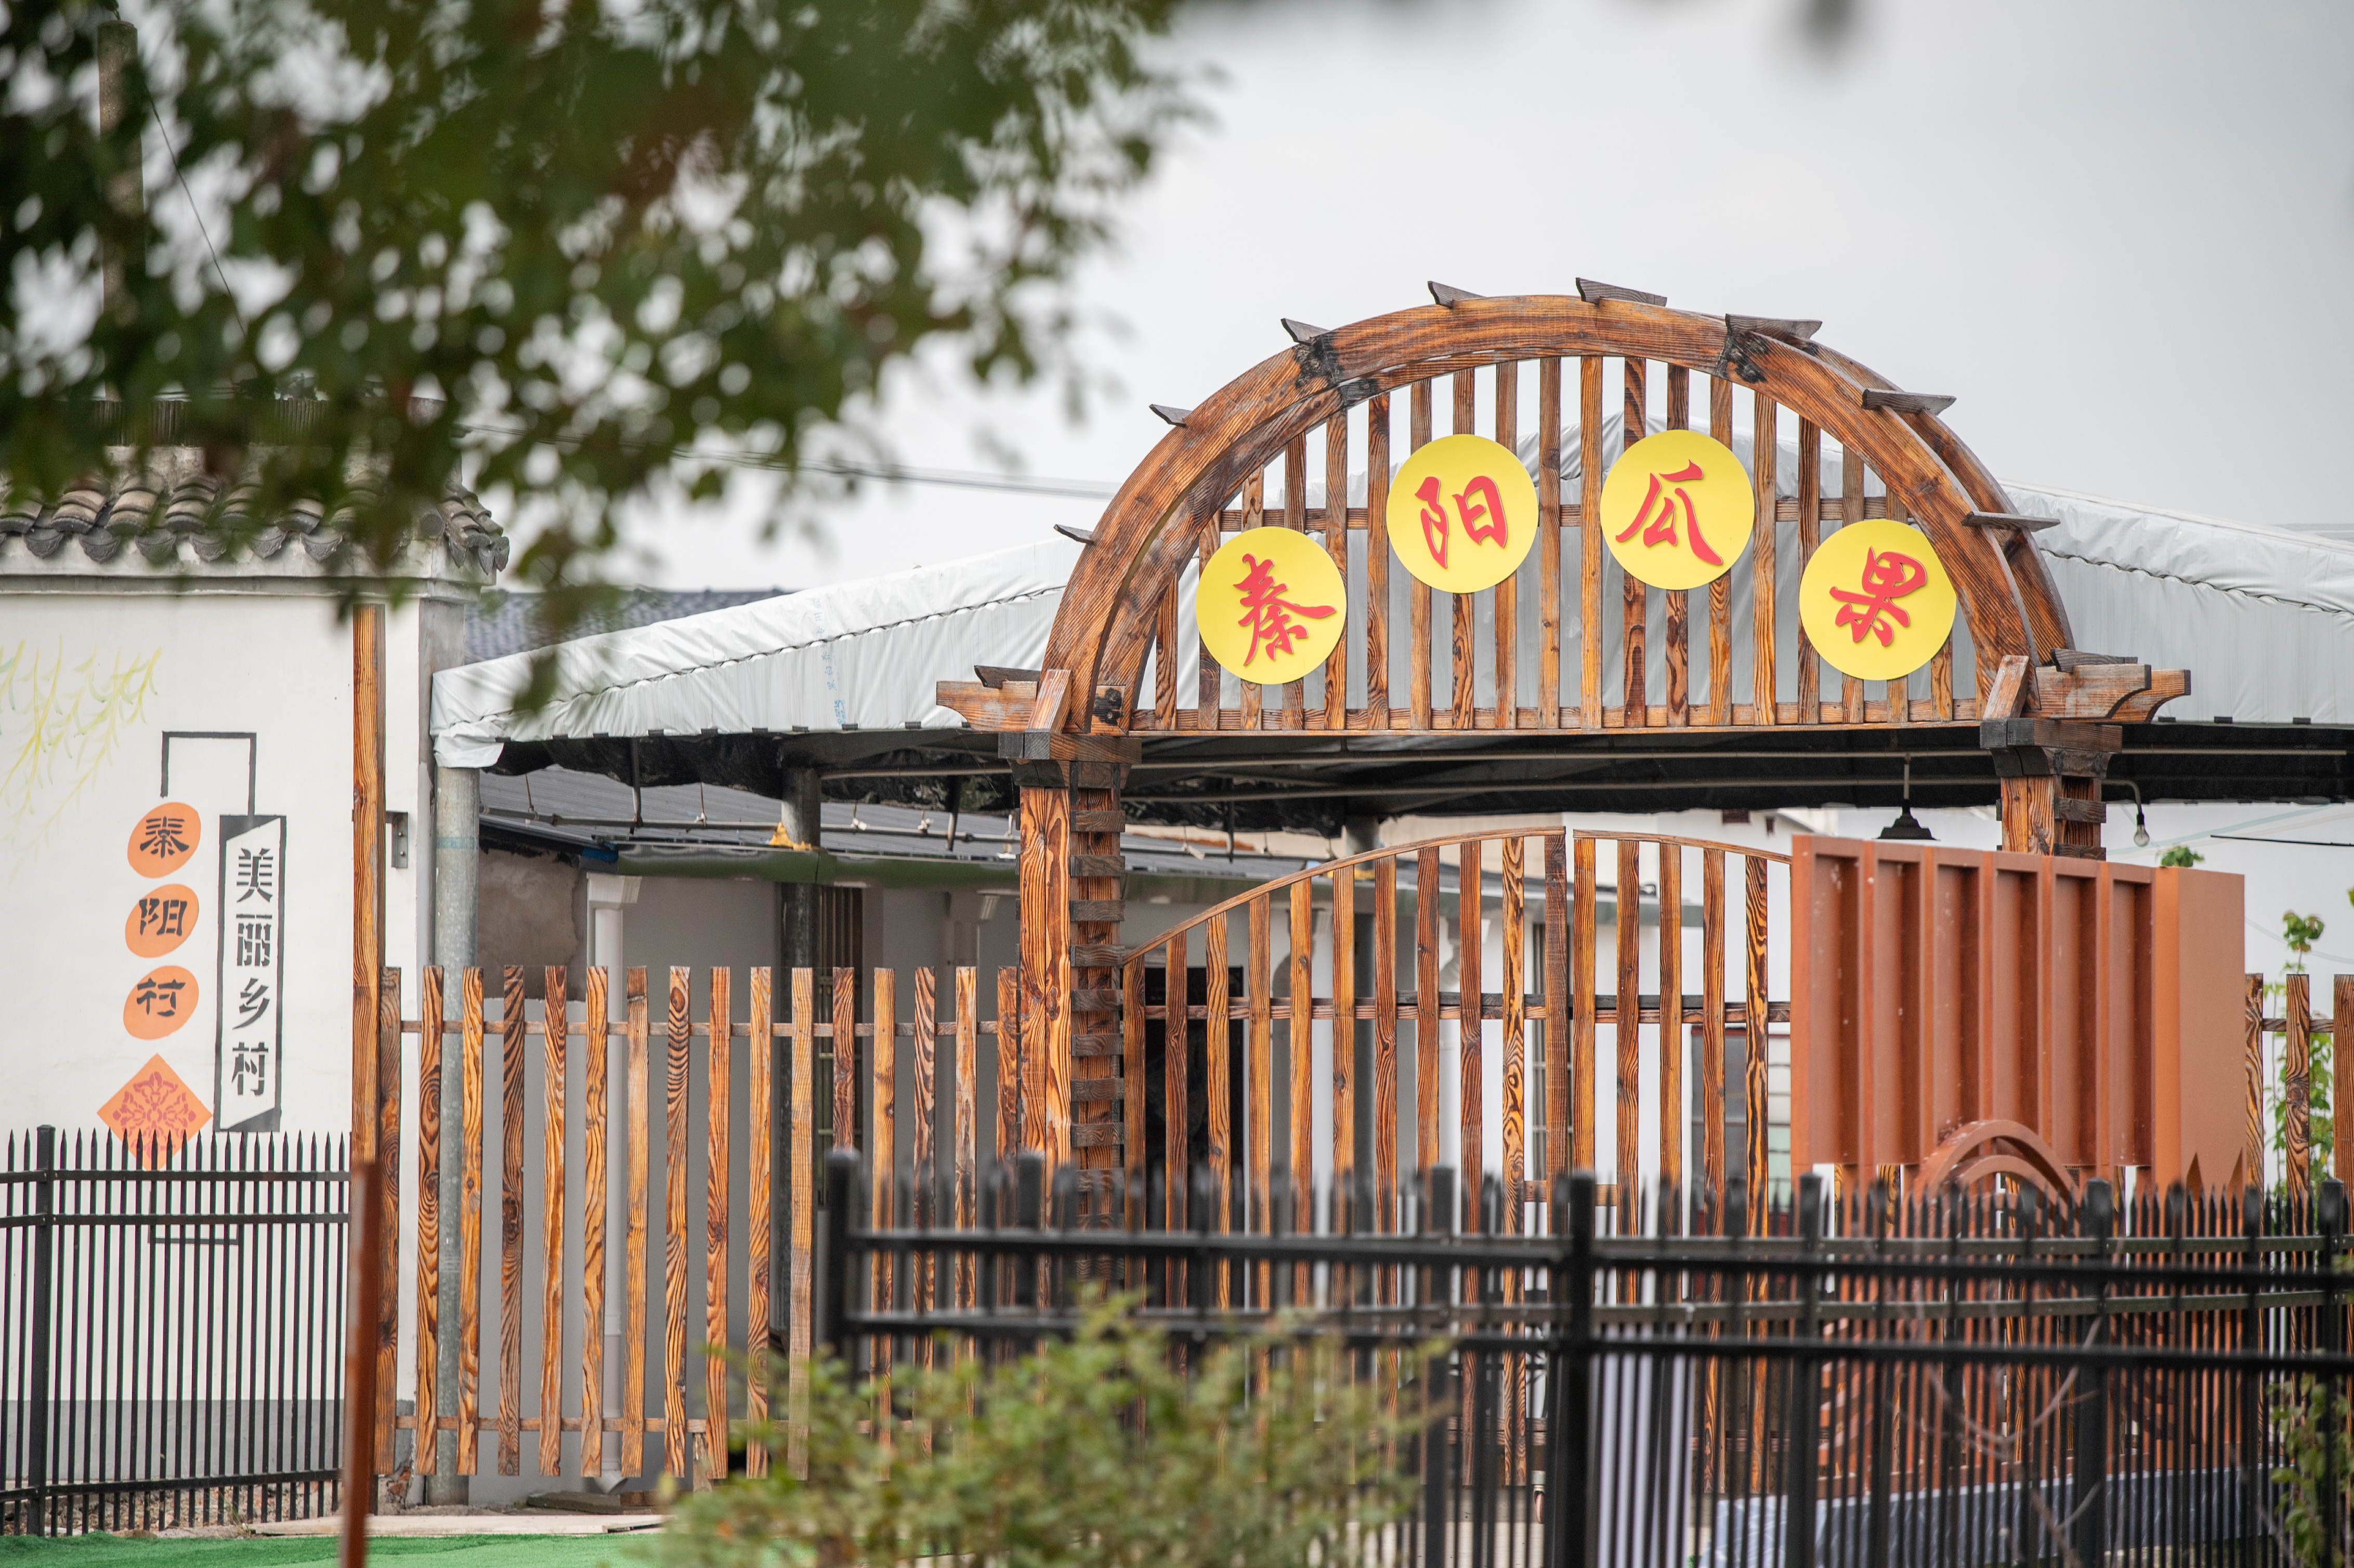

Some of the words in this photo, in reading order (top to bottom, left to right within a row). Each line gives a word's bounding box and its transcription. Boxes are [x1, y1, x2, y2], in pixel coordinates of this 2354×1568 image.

[1233, 460, 1926, 666] 秦阳瓜果
[232, 848, 273, 1095] 美丽乡村
